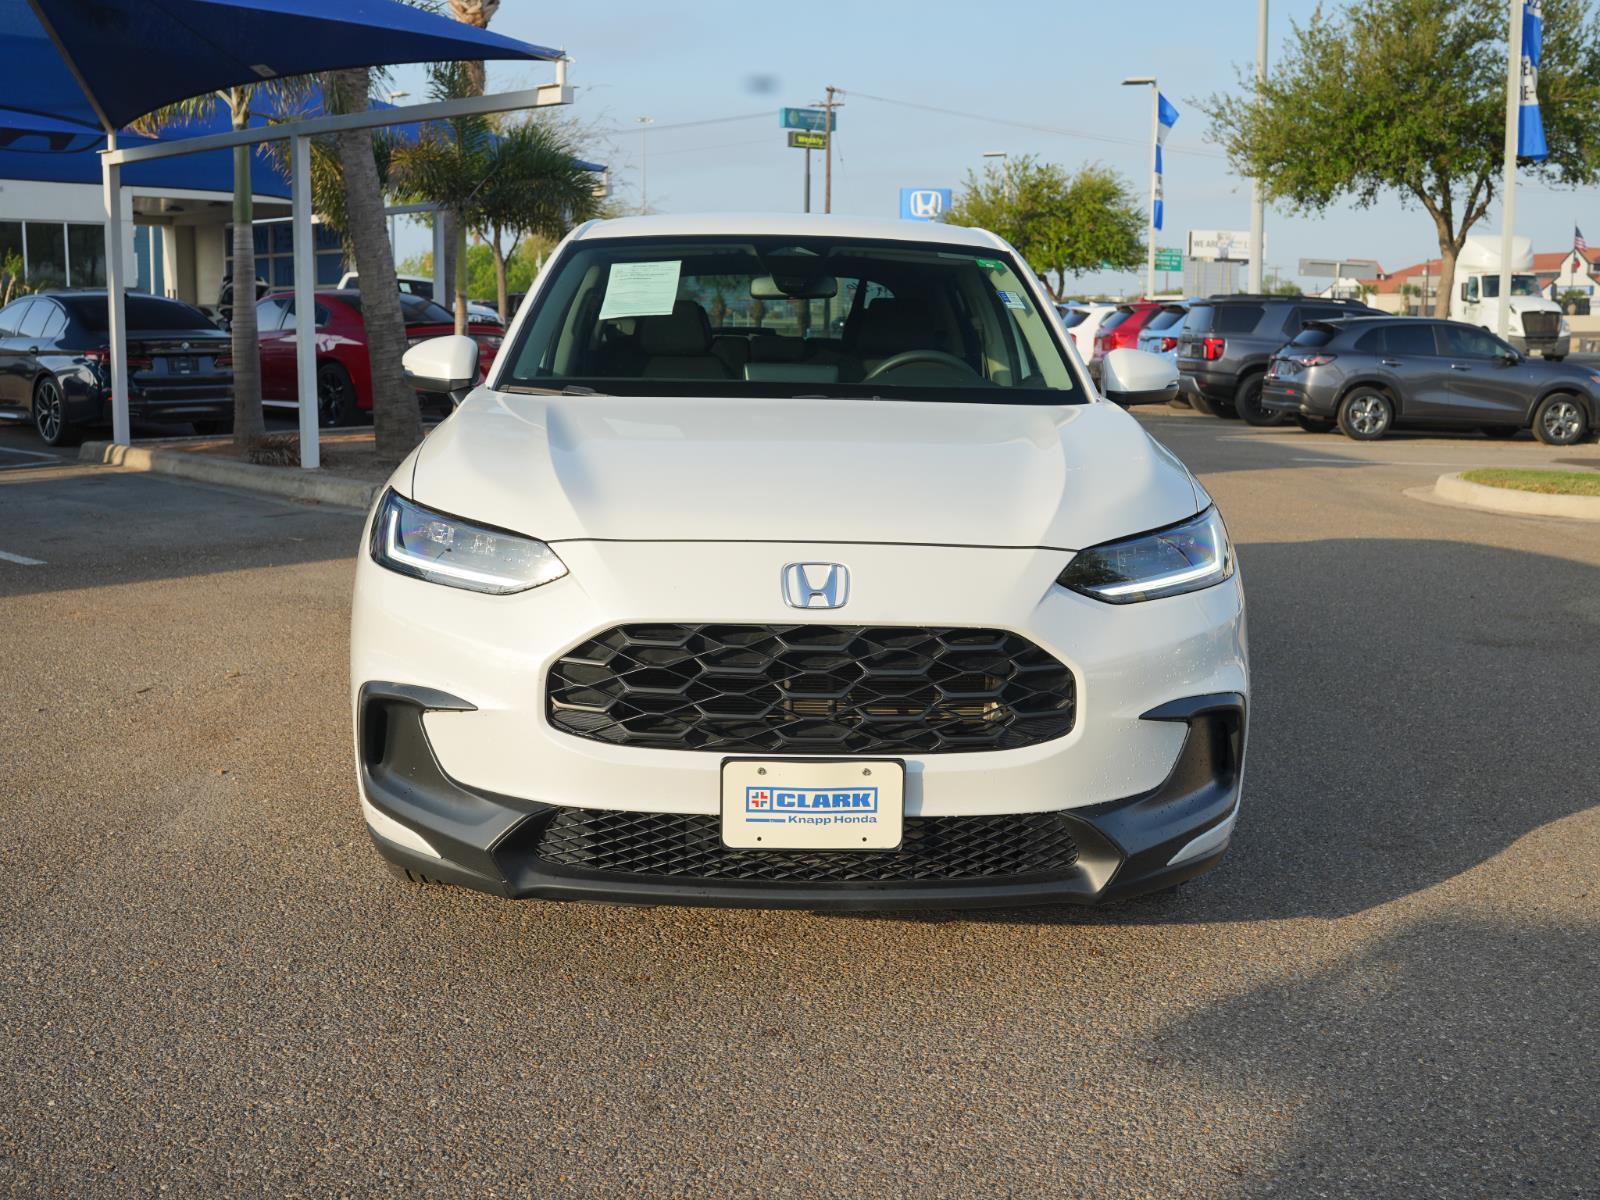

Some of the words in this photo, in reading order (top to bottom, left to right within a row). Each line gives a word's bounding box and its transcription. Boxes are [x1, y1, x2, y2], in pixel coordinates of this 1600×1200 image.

[776, 793, 871, 808] CLARK
[788, 815, 832, 825] Knapp
[834, 815, 878, 824] Honda
